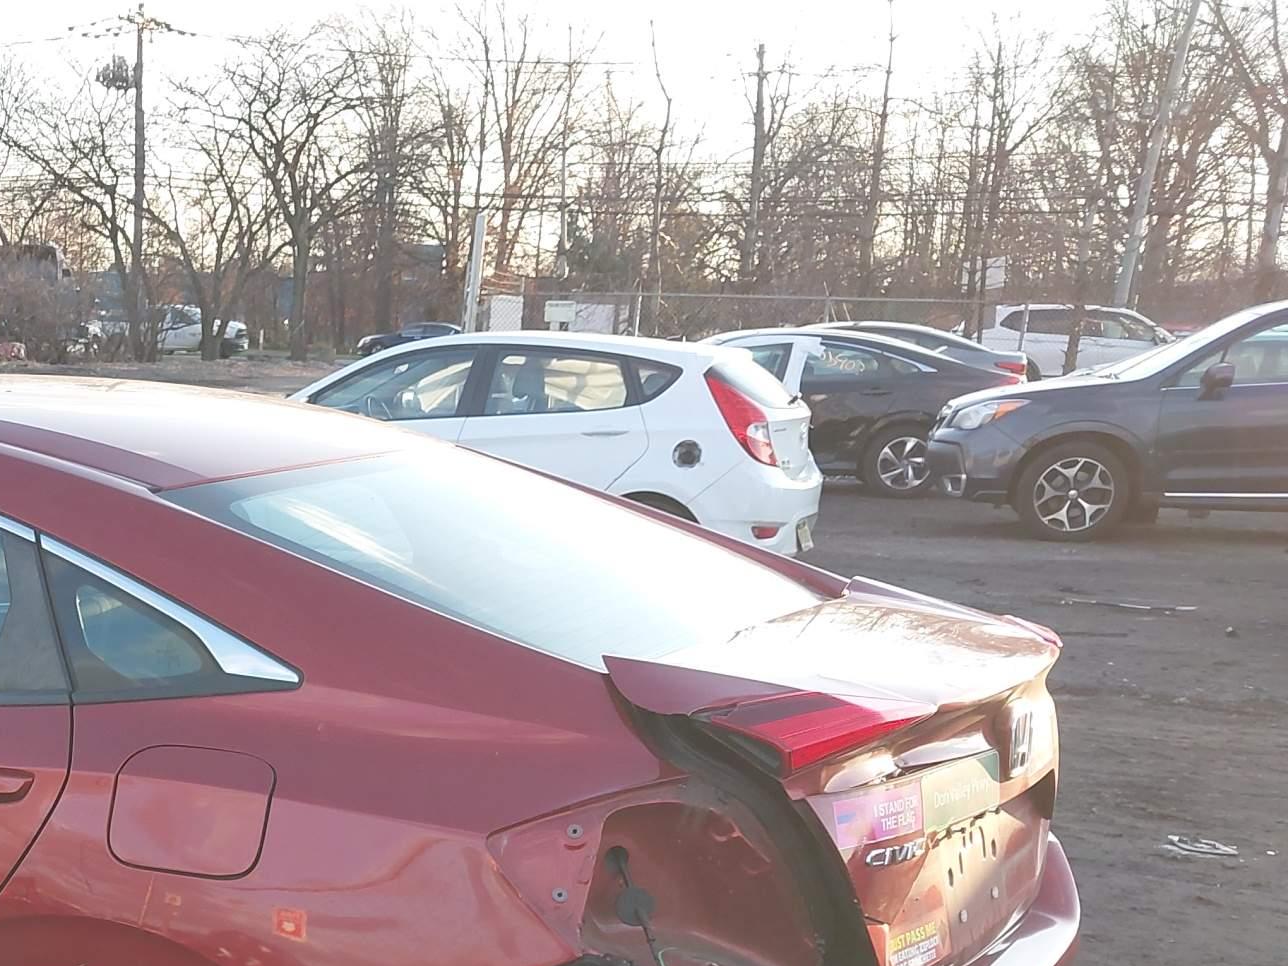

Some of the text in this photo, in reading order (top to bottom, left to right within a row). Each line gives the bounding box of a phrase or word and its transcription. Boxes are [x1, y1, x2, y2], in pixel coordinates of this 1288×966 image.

[878, 799, 905, 817] STAND
[880, 810, 916, 832] THE FLAG
[865, 837, 926, 866] CIVIC
[905, 925, 926, 946] PASS
[924, 919, 938, 937] ME
